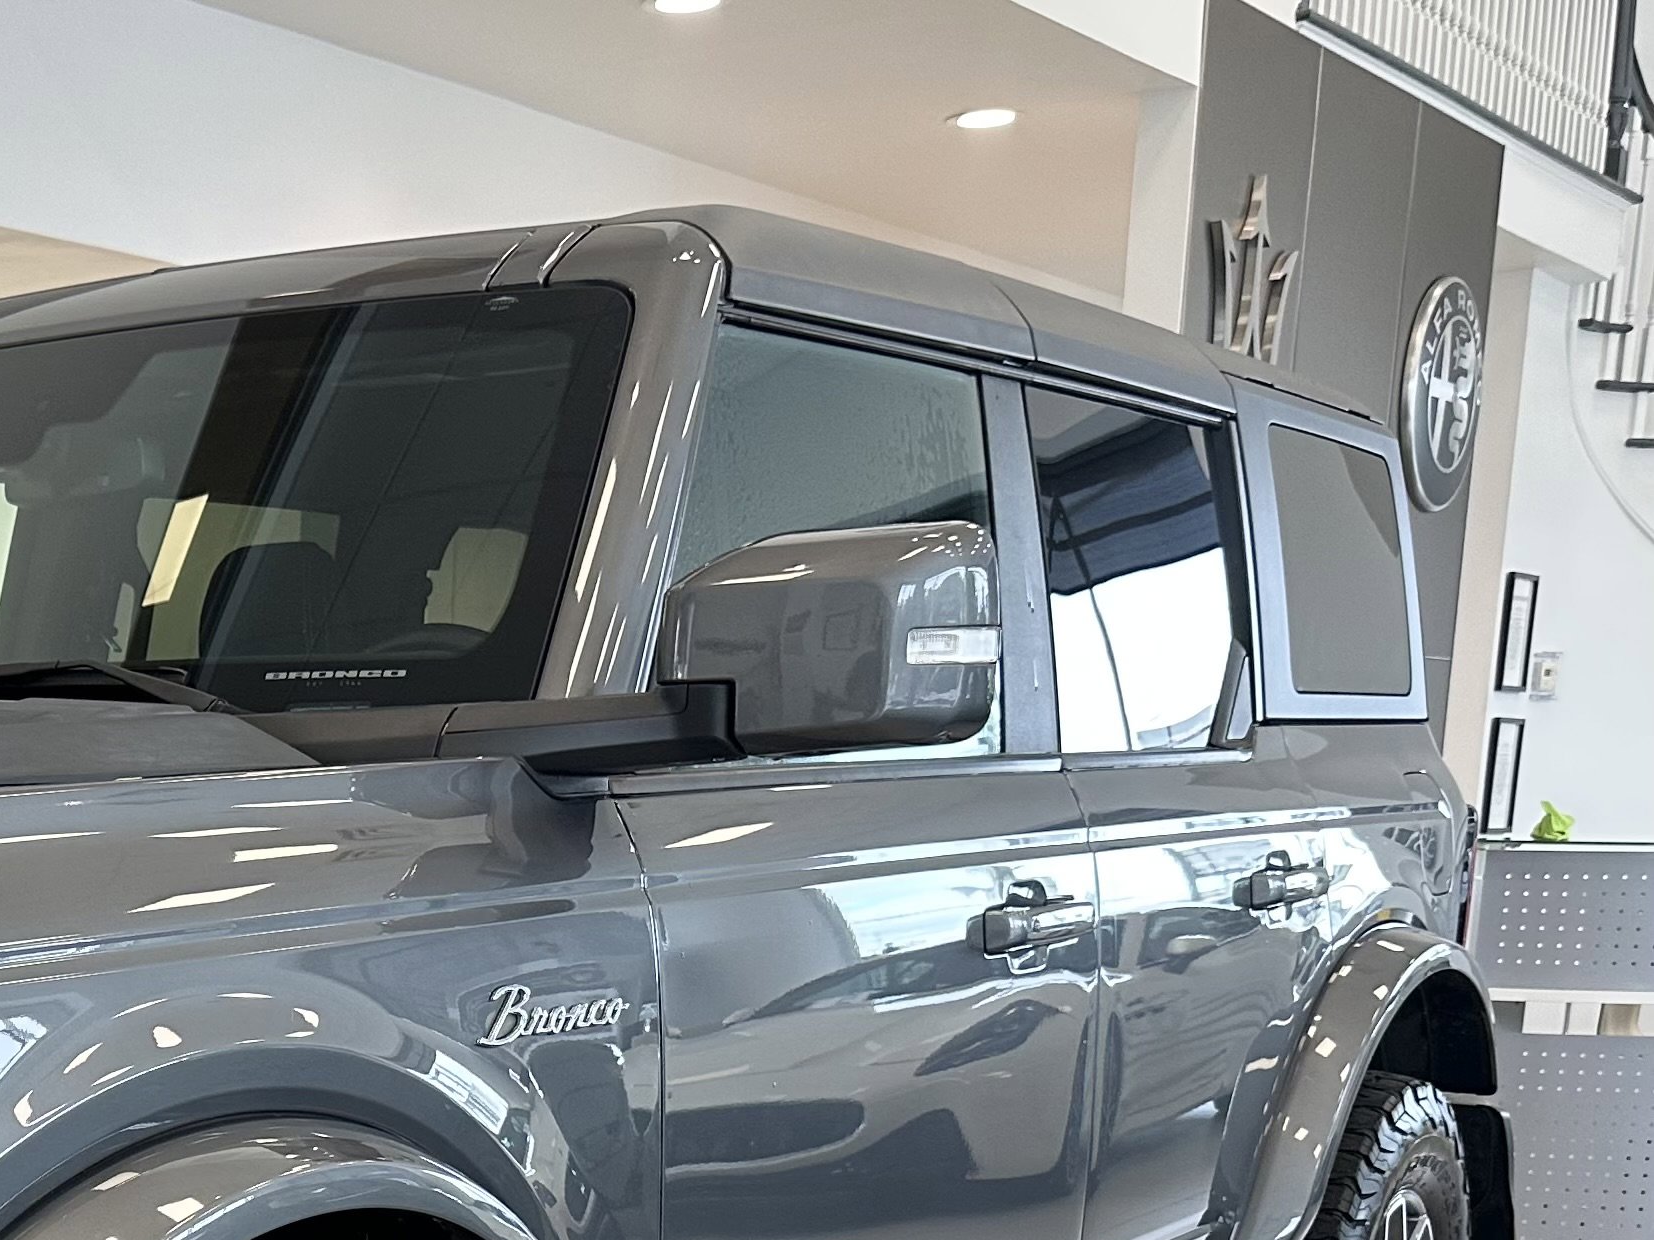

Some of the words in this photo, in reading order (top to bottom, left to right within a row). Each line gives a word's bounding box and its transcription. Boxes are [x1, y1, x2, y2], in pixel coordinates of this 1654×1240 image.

[1420, 296, 1453, 385] ALFA
[264, 669, 408, 681] BRONCO
[475, 983, 630, 1047] Bronco
